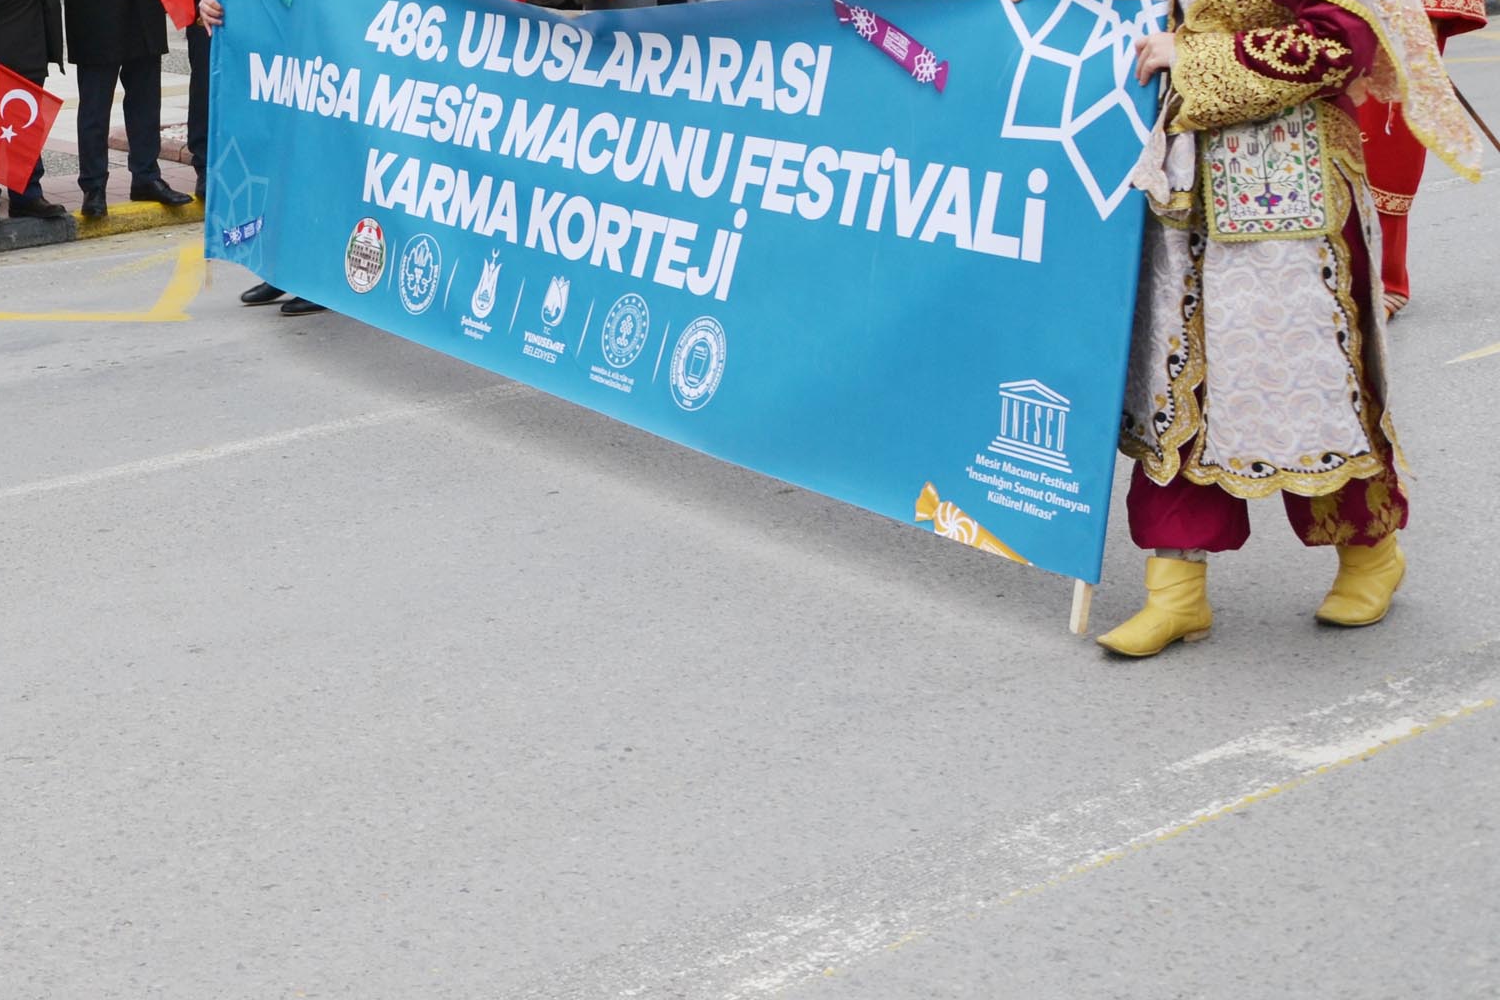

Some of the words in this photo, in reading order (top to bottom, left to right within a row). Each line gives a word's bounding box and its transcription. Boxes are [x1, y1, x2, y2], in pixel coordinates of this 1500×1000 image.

[365, 0, 449, 62] 486.
[457, 10, 832, 116] ULUSLARARASI
[499, 98, 734, 198] MACUNU
[362, 148, 518, 244] KARMA
[1000, 397, 1066, 451] UNESCO
[975, 453, 1001, 470] Mesir
[1002, 461, 1039, 481] Macunu
[1040, 472, 1079, 493] Festivali
[987, 490, 1022, 510] Kültürel
[1013, 481, 1043, 499] Somut
[1044, 491, 1090, 513] Olmayan
